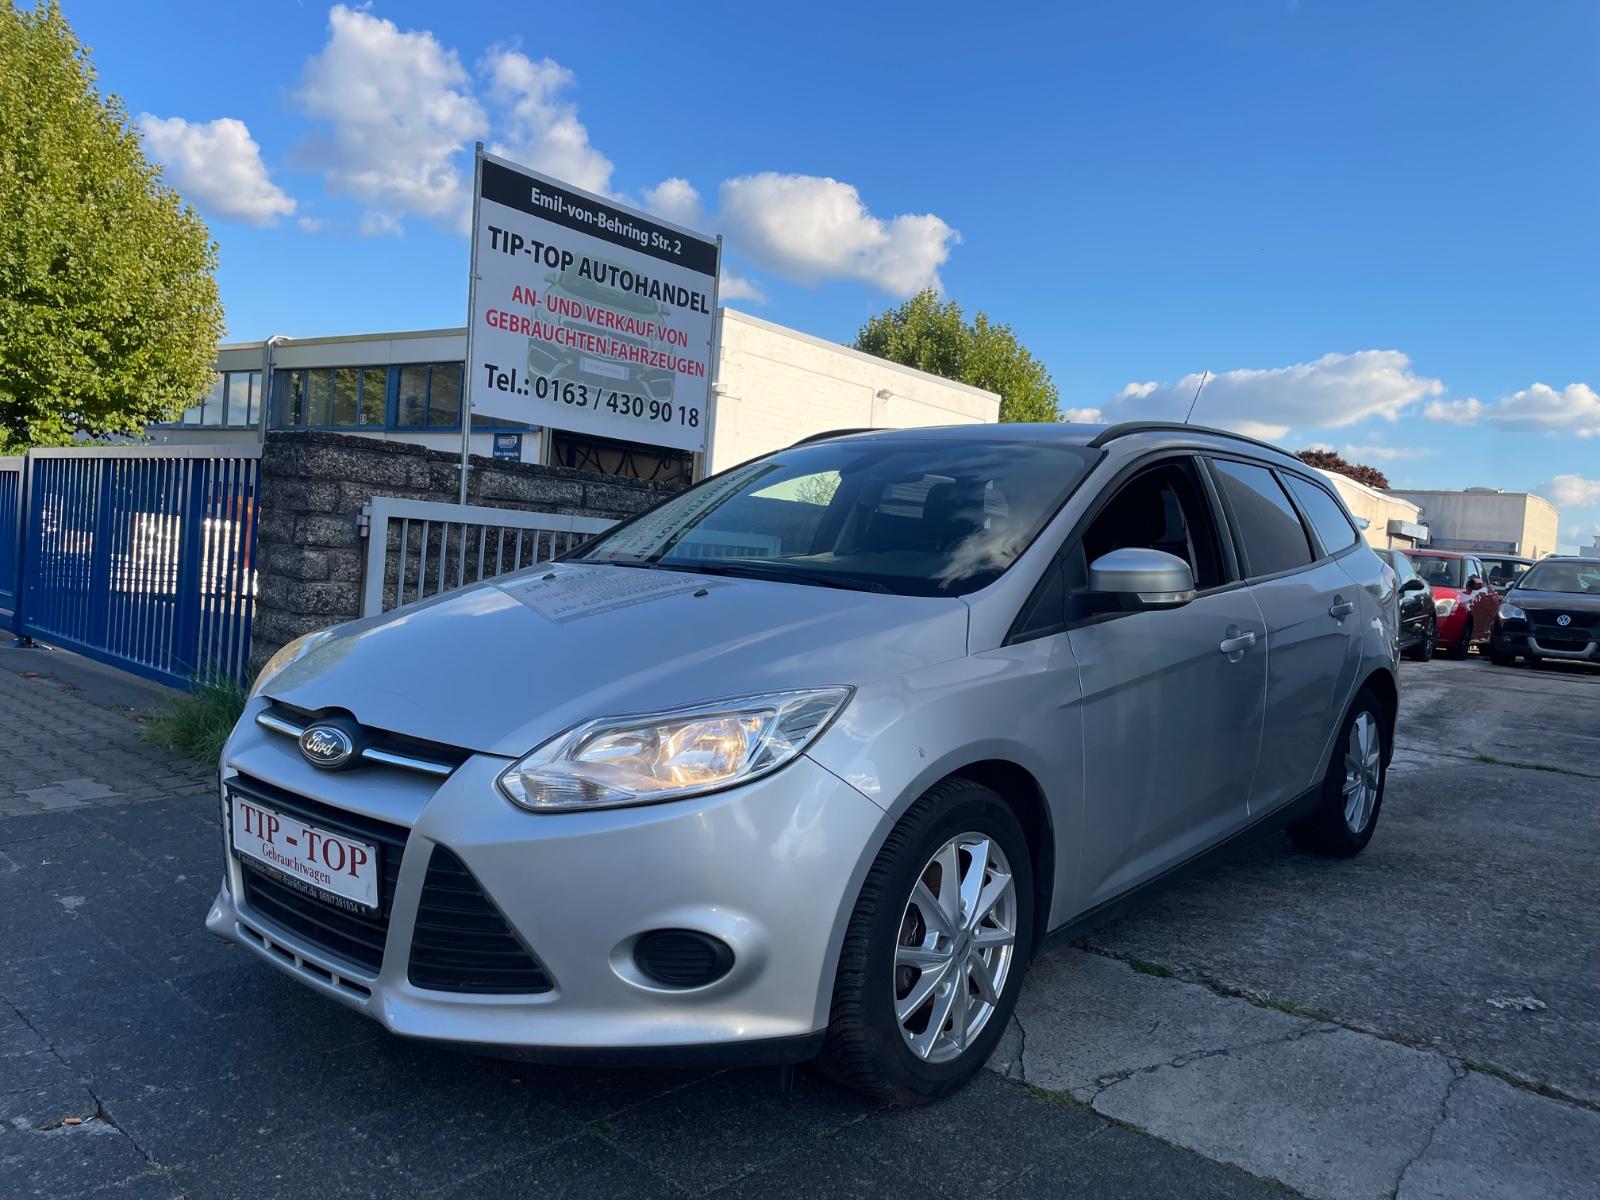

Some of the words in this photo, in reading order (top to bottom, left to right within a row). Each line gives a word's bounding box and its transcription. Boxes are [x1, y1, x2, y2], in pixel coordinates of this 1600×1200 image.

[531, 187, 649, 247] Emil-von-Behring
[651, 231, 672, 252] Str.
[673, 240, 682, 255] 2
[488, 225, 574, 271] TIP-TOP
[578, 257, 710, 315] AUTOHANDEL
[485, 309, 607, 355] GEBRAUCHTEN
[610, 341, 705, 378] FAHRZEUGEN
[511, 285, 542, 307] AN-
[546, 294, 583, 319] UND
[585, 305, 654, 338] VERKAUF
[657, 325, 689, 348] VON
[484, 363, 530, 396] Tel.:
[535, 376, 588, 407] 0163
[593, 388, 602, 410] /
[606, 392, 644, 418] 430
[650, 400, 673, 423] 90
[679, 406, 699, 428] 18
[306, 730, 335, 756] Ford
[262, 842, 331, 885] Gebrauchtwagen
